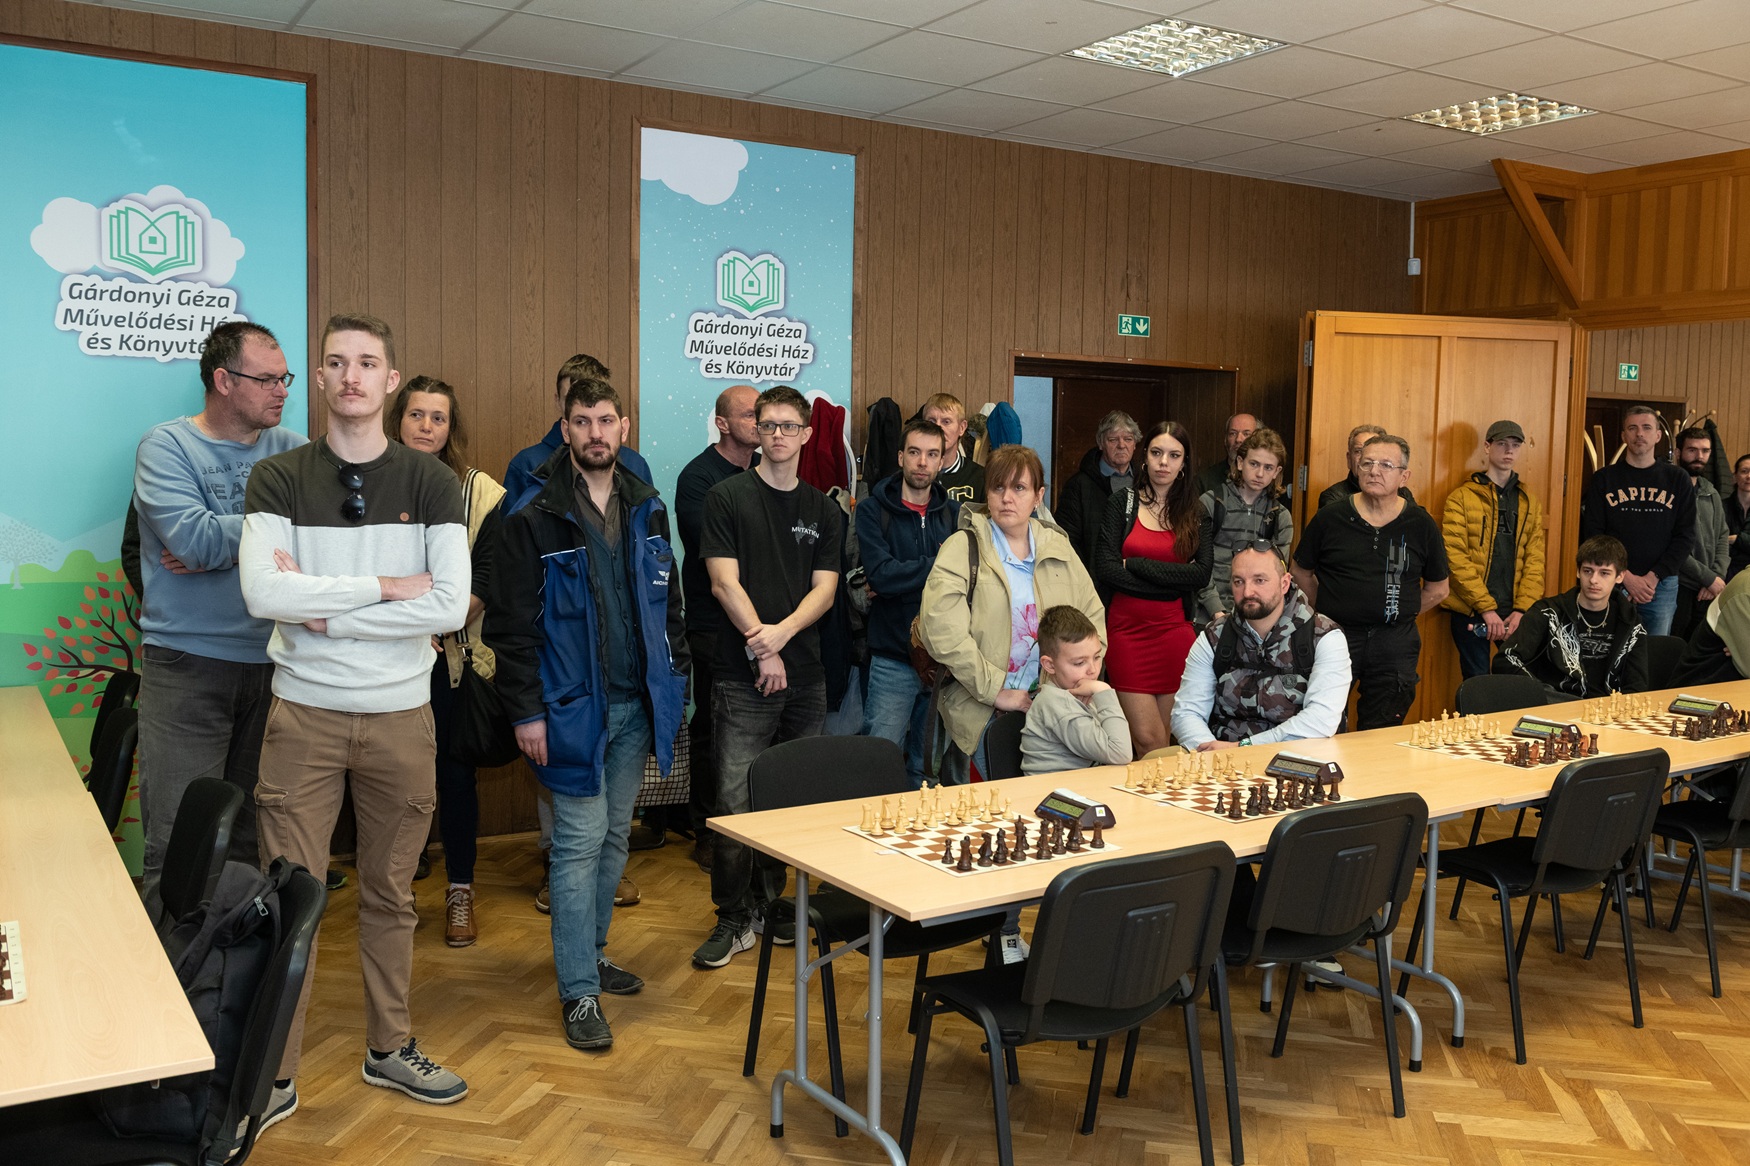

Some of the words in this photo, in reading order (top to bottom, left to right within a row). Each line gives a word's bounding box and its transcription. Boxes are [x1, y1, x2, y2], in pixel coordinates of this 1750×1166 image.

[68, 282, 172, 309] Gárdonyi
[177, 289, 230, 308] Géza
[62, 308, 195, 331] Művelődési
[694, 319, 763, 339] Gárdonyi
[766, 323, 802, 339] Géza
[86, 332, 112, 350] és
[118, 334, 207, 357] Könyvt
[690, 339, 778, 358] Művelődési
[781, 345, 809, 359] Ház
[704, 359, 722, 374] és
[726, 360, 795, 379] Könyvtár
[202, 463, 232, 475] JEAN
[236, 461, 256, 469] PA
[1605, 487, 1675, 509] CAPITAL
